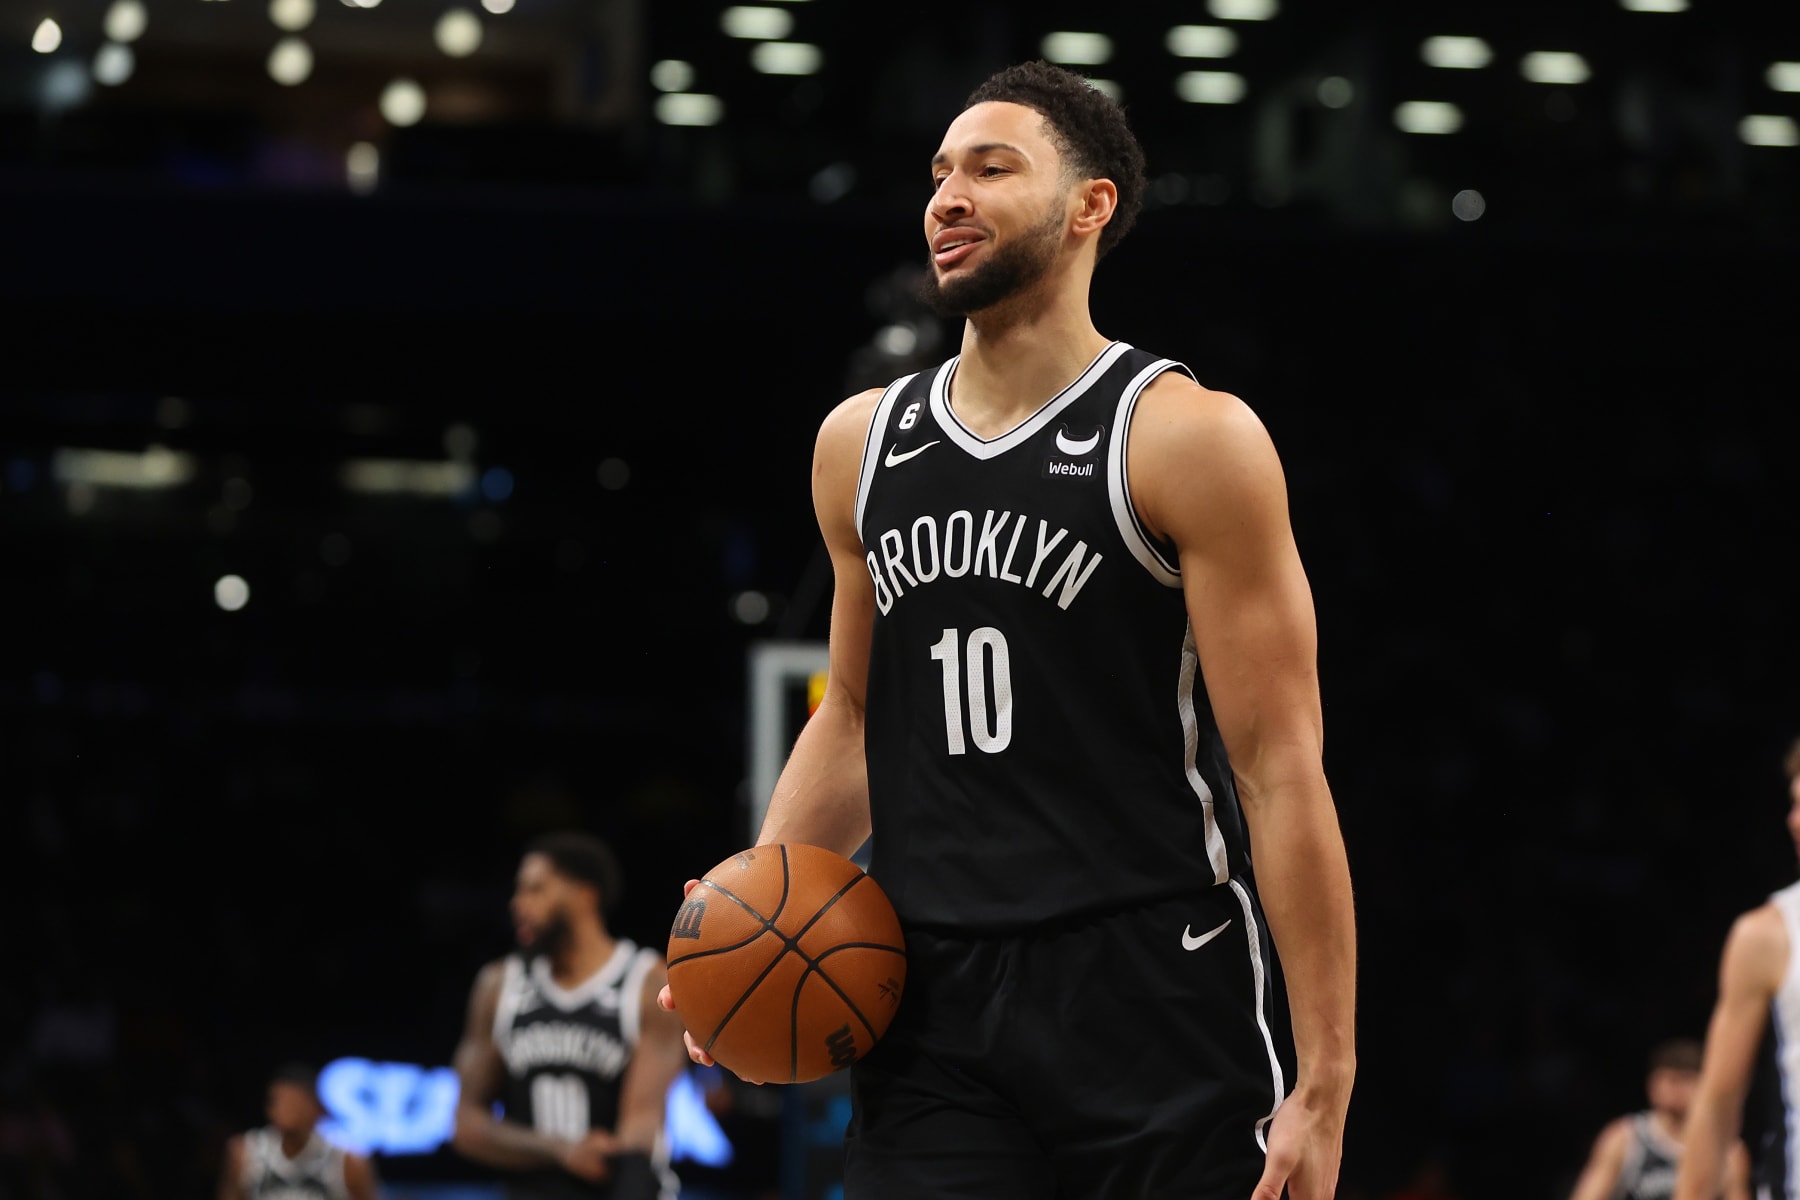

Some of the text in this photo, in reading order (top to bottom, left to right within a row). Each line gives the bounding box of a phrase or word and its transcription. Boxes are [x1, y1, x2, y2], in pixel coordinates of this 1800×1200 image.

[898, 402, 921, 430] 6
[1048, 461, 1094, 477] Webull
[866, 509, 1103, 616] BROOKLYN
[930, 626, 1013, 756] 10
